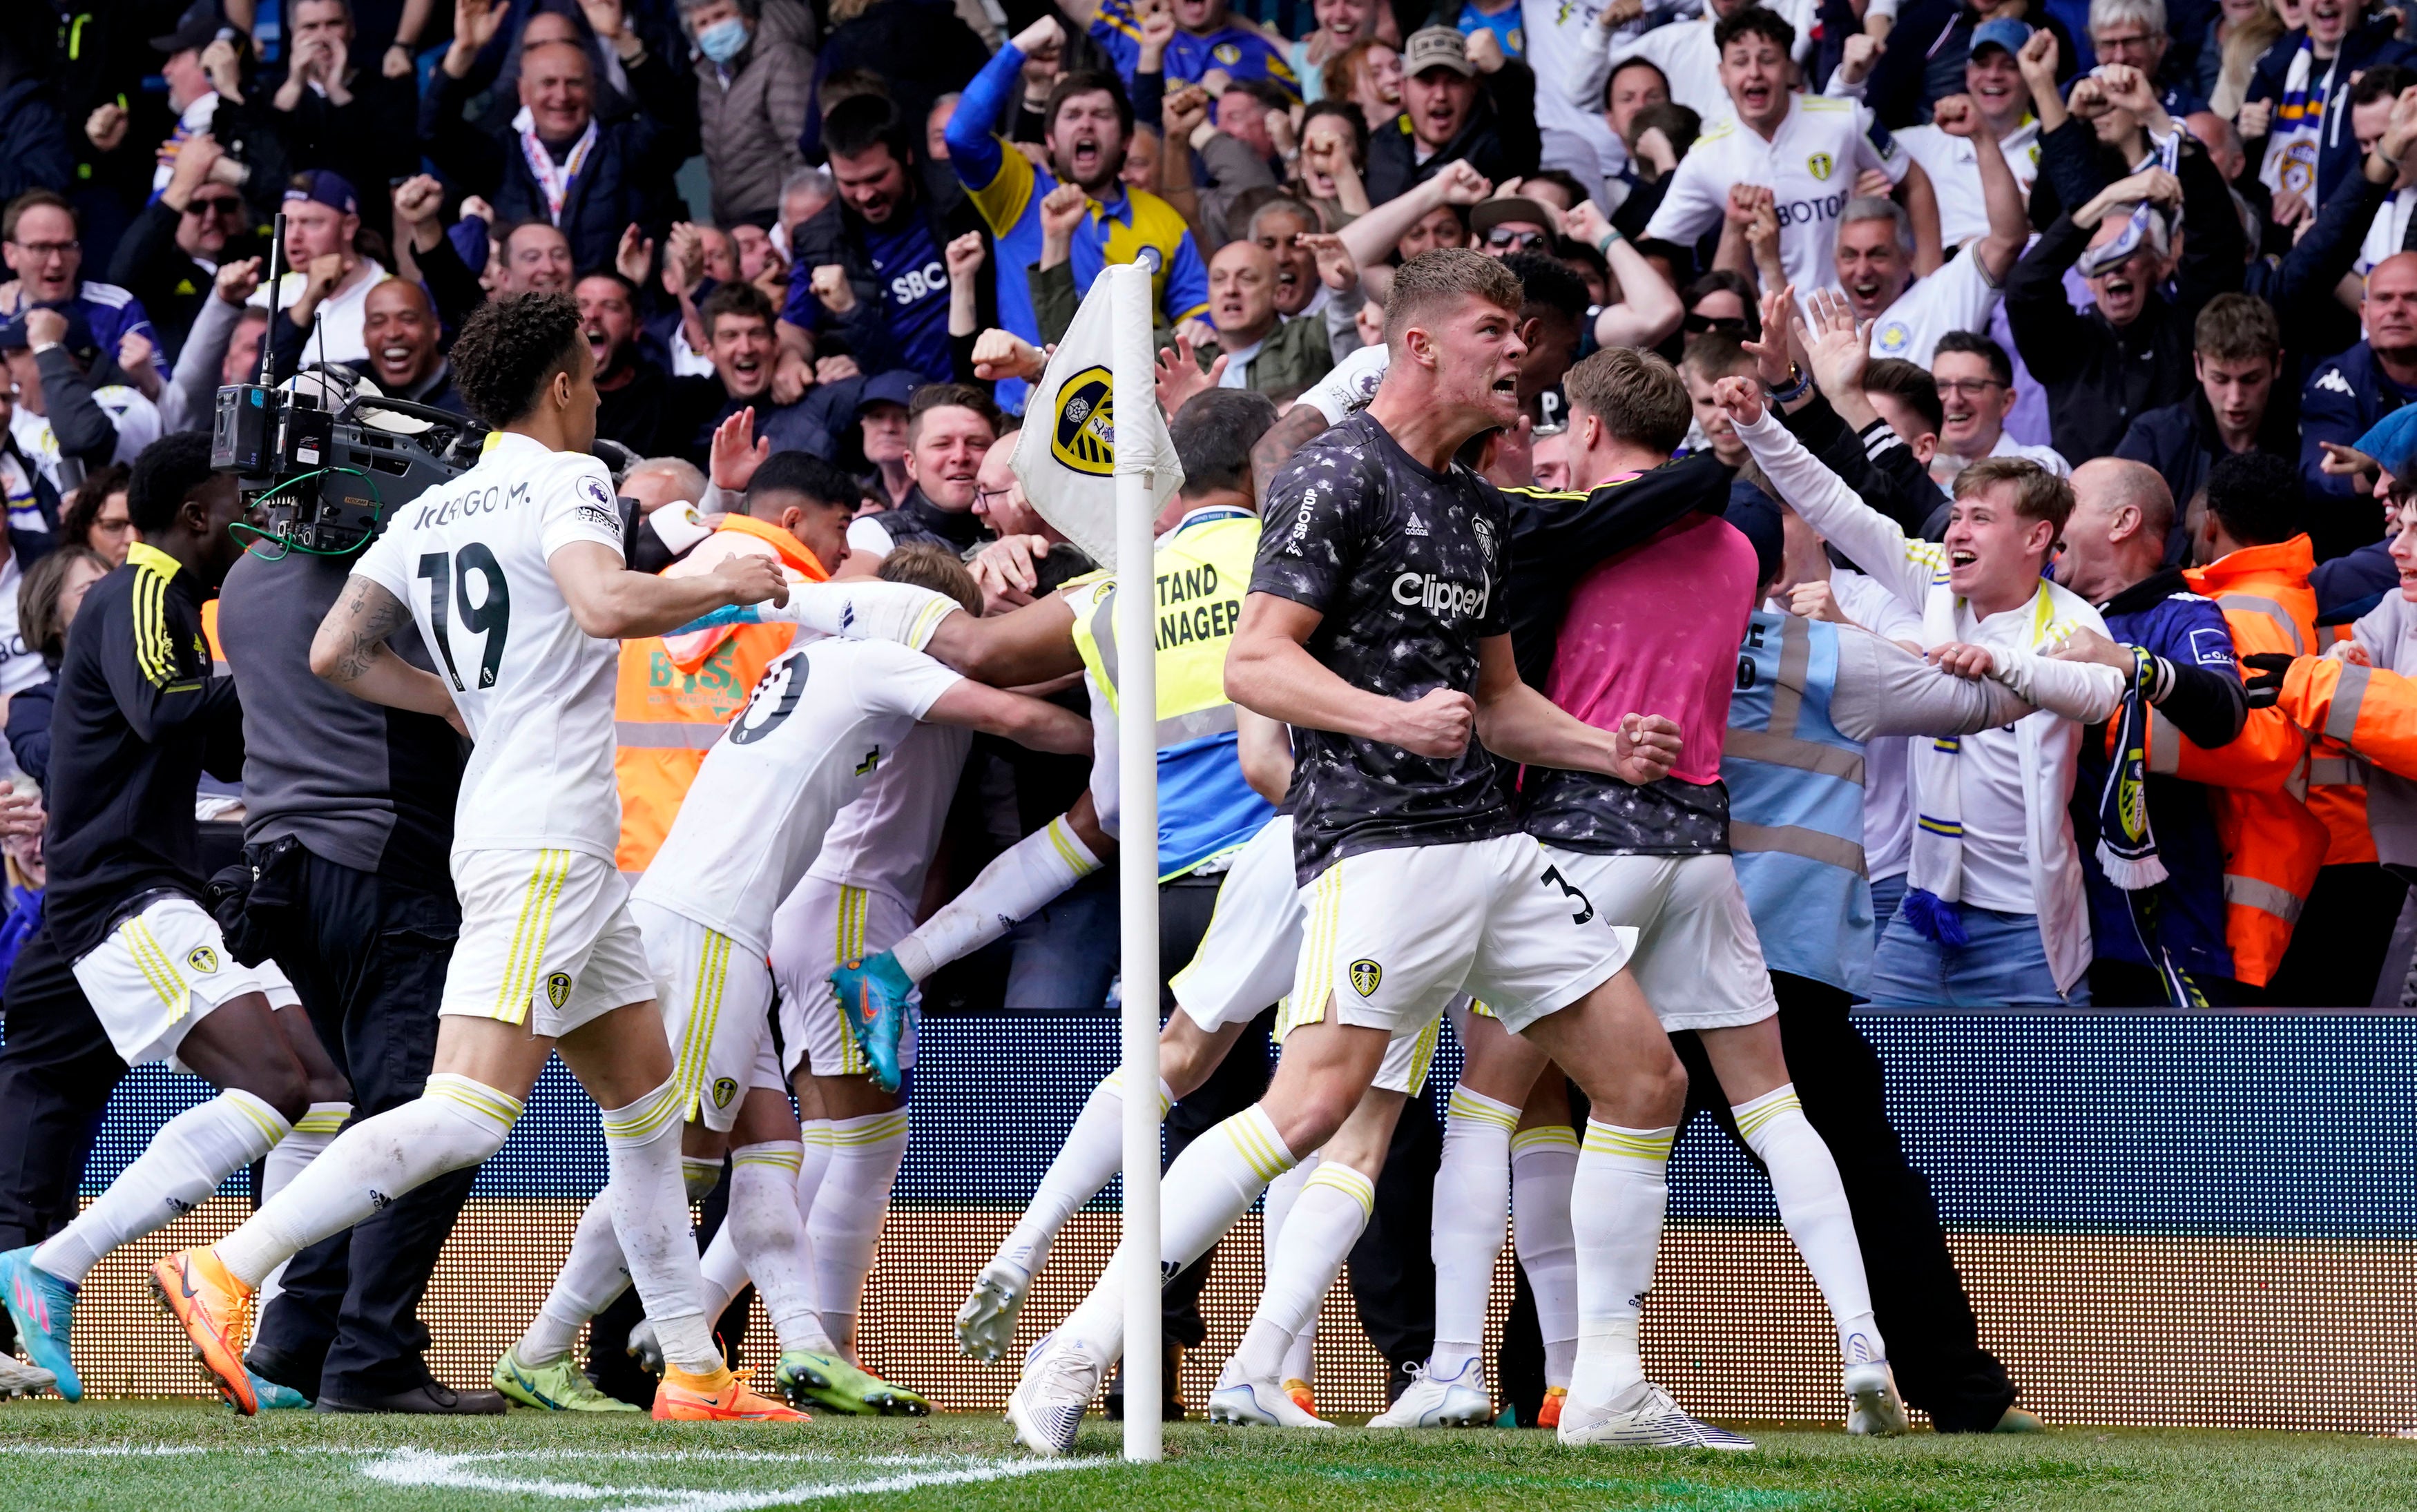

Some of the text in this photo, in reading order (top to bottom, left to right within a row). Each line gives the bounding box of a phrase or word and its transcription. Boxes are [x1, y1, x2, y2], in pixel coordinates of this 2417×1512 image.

[1775, 188, 1850, 226] BOTO
[1292, 488, 1318, 540] SBOTOP
[1405, 527, 1429, 536] adidas
[1156, 563, 1218, 607] TAND
[417, 542, 510, 692] 19
